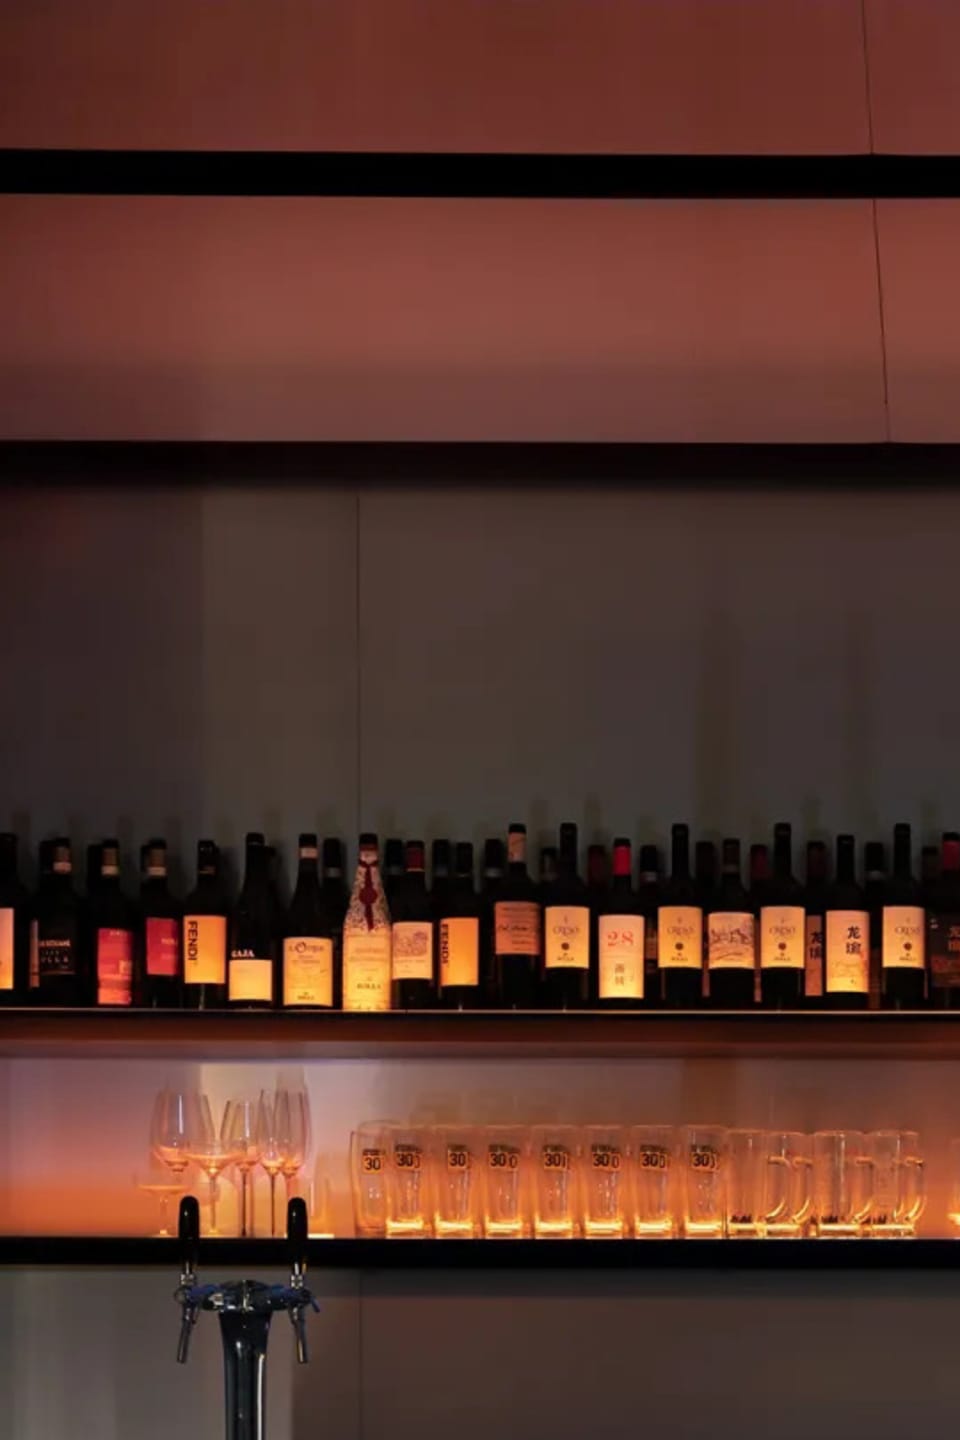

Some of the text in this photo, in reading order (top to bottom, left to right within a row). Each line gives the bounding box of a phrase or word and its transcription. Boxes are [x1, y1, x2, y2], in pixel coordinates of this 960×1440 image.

[188, 920, 198, 960] FENDI
[365, 1158, 380, 1170] 30
[397, 1154, 414, 1166] 30
[450, 1154, 466, 1166] 30
[490, 1154, 506, 1166] 30
[544, 1154, 561, 1167] 30
[594, 1154, 610, 1167] 30
[642, 1154, 658, 1167] 30
[693, 1154, 709, 1167] 30
